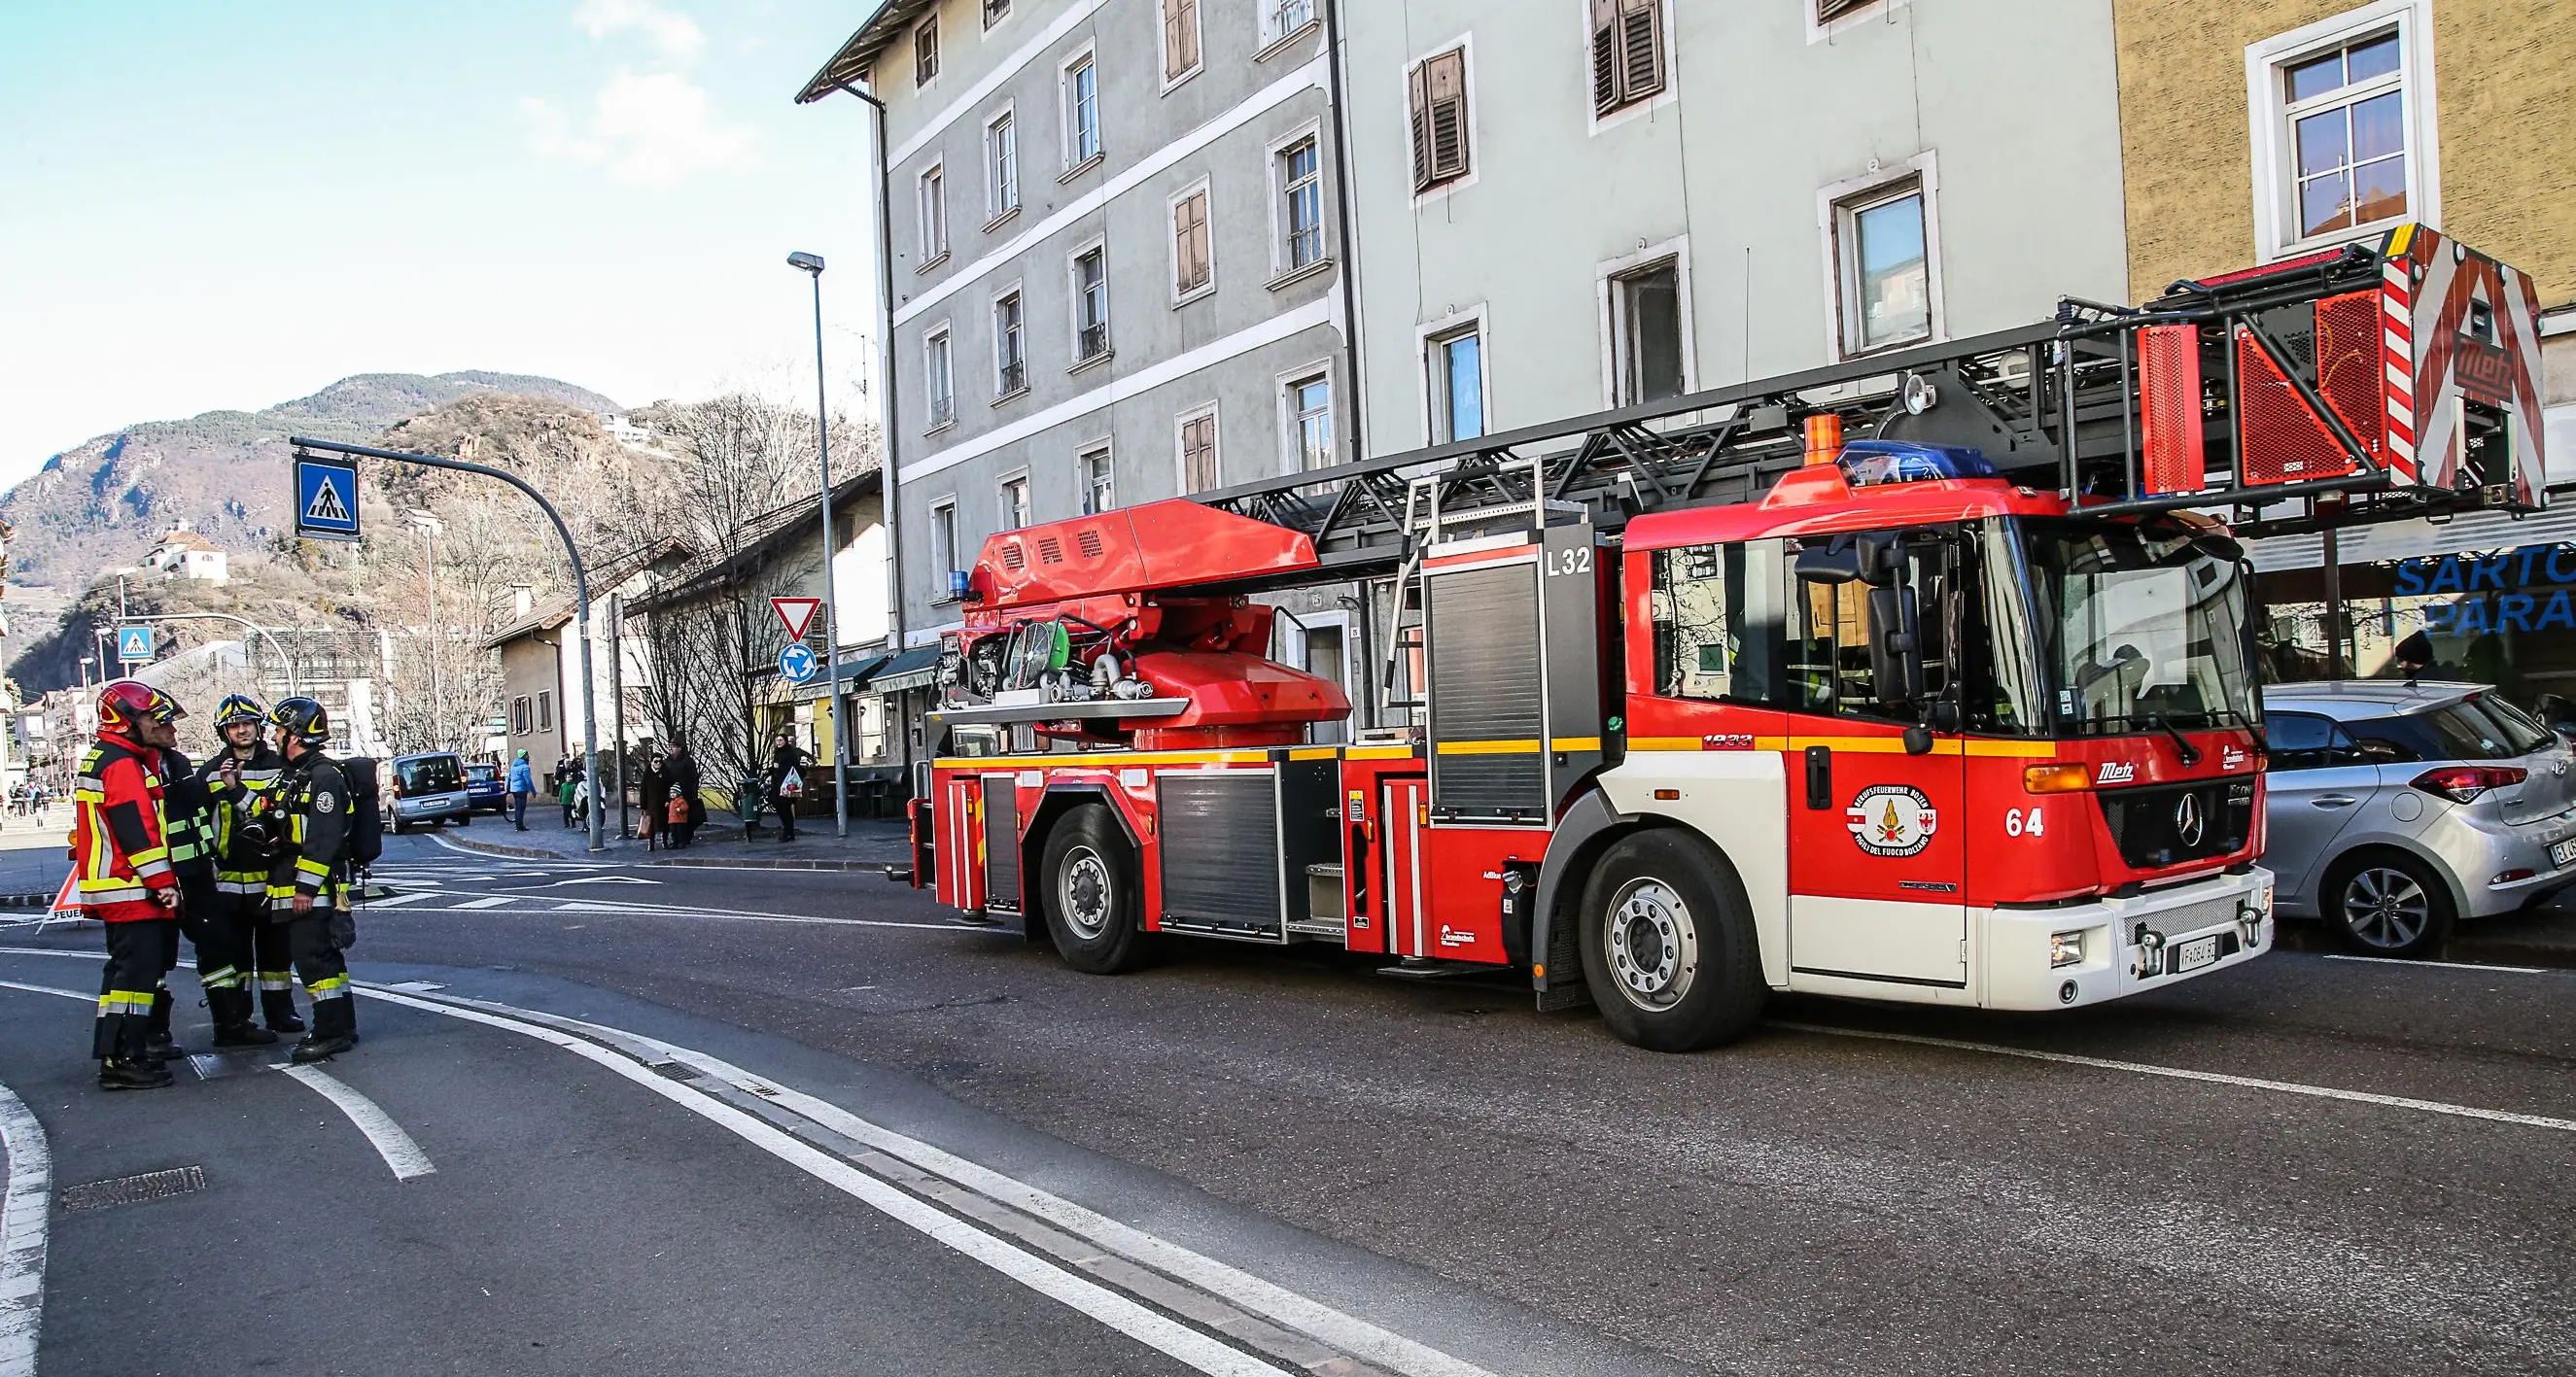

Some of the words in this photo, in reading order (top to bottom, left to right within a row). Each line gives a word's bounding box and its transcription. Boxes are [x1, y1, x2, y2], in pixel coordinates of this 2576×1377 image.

[1855, 786, 1908, 808] BERUFSFEUERWEHR
[1910, 789, 1930, 809] BOZEN
[2005, 808, 2044, 837] 64
[1855, 834, 1870, 851] VIGILI
[1870, 846, 1882, 856] DEL
[1883, 847, 1904, 857] FUOCO
[1904, 836, 1930, 856] BOLZANO
